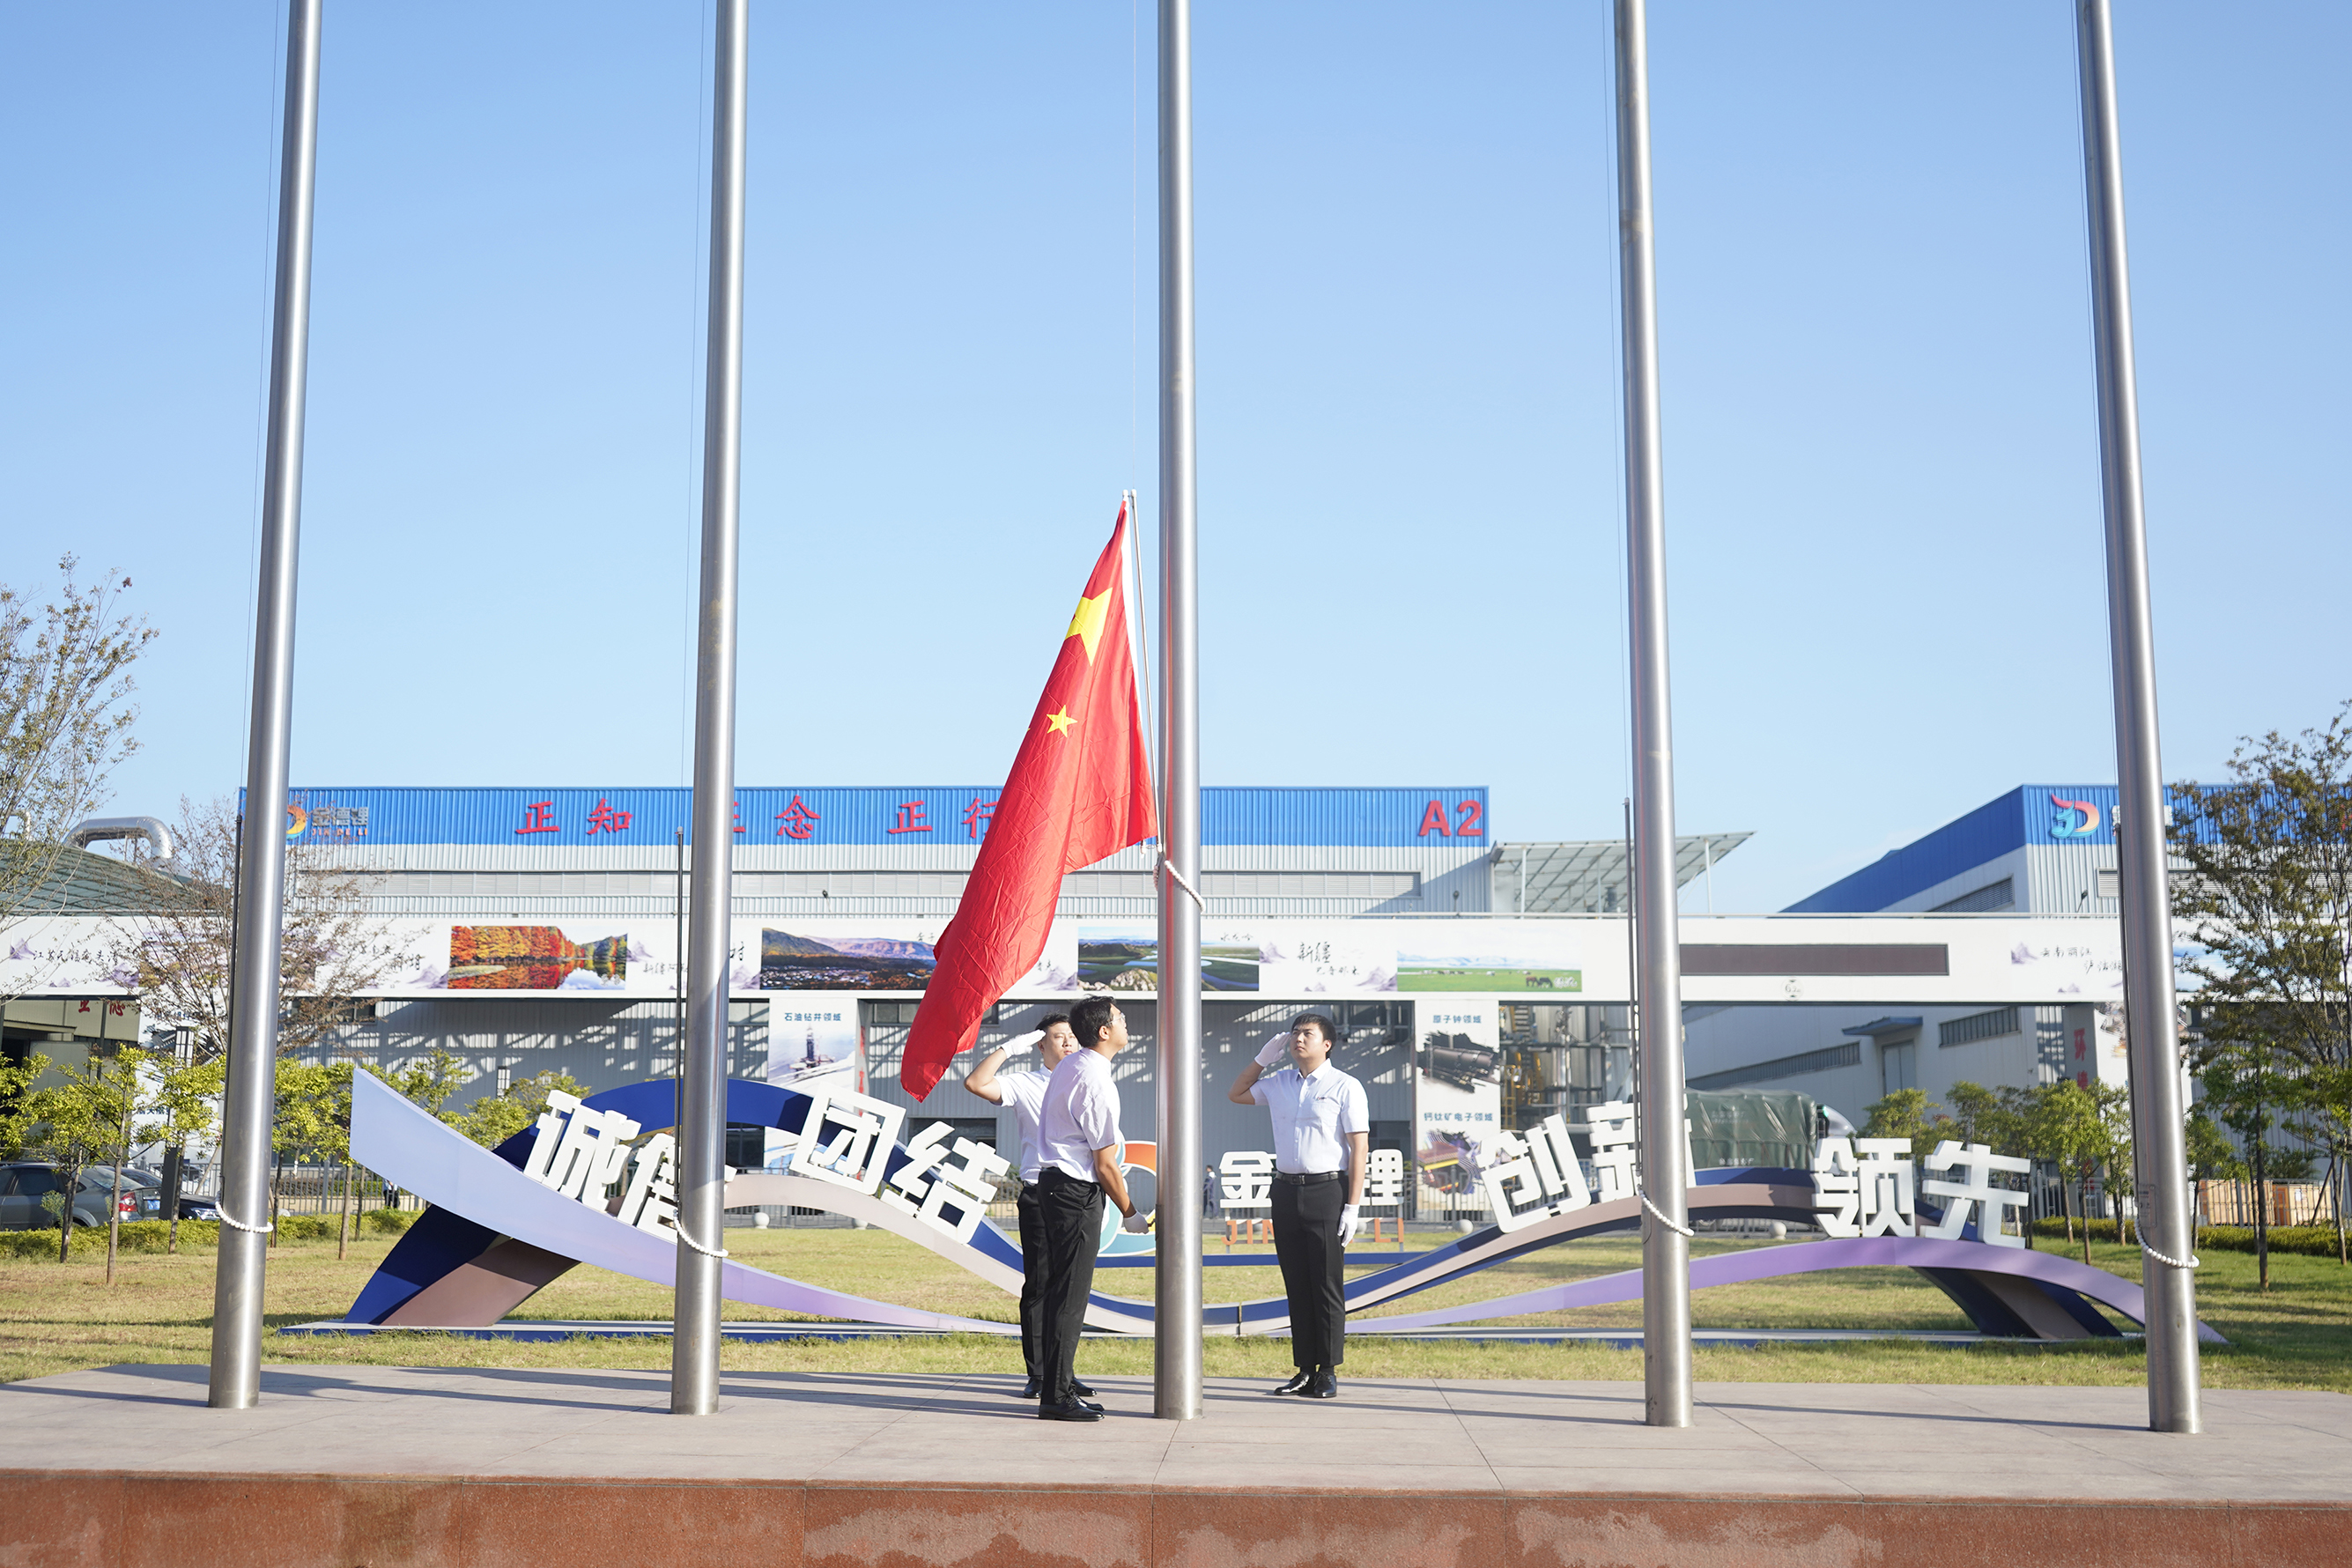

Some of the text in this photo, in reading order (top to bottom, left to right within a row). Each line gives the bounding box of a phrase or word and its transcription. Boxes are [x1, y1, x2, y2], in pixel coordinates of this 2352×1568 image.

[514, 797, 633, 835] 正知
[1418, 799, 1483, 837] A2
[784, 1012, 841, 1022] 石油钻井领域
[1424, 1112, 1493, 1122] 钙钛矿电子领域
[791, 1081, 1011, 1245] 团结
[1218, 1149, 1404, 1209] 金理
[1812, 1137, 2030, 1248] 领先
